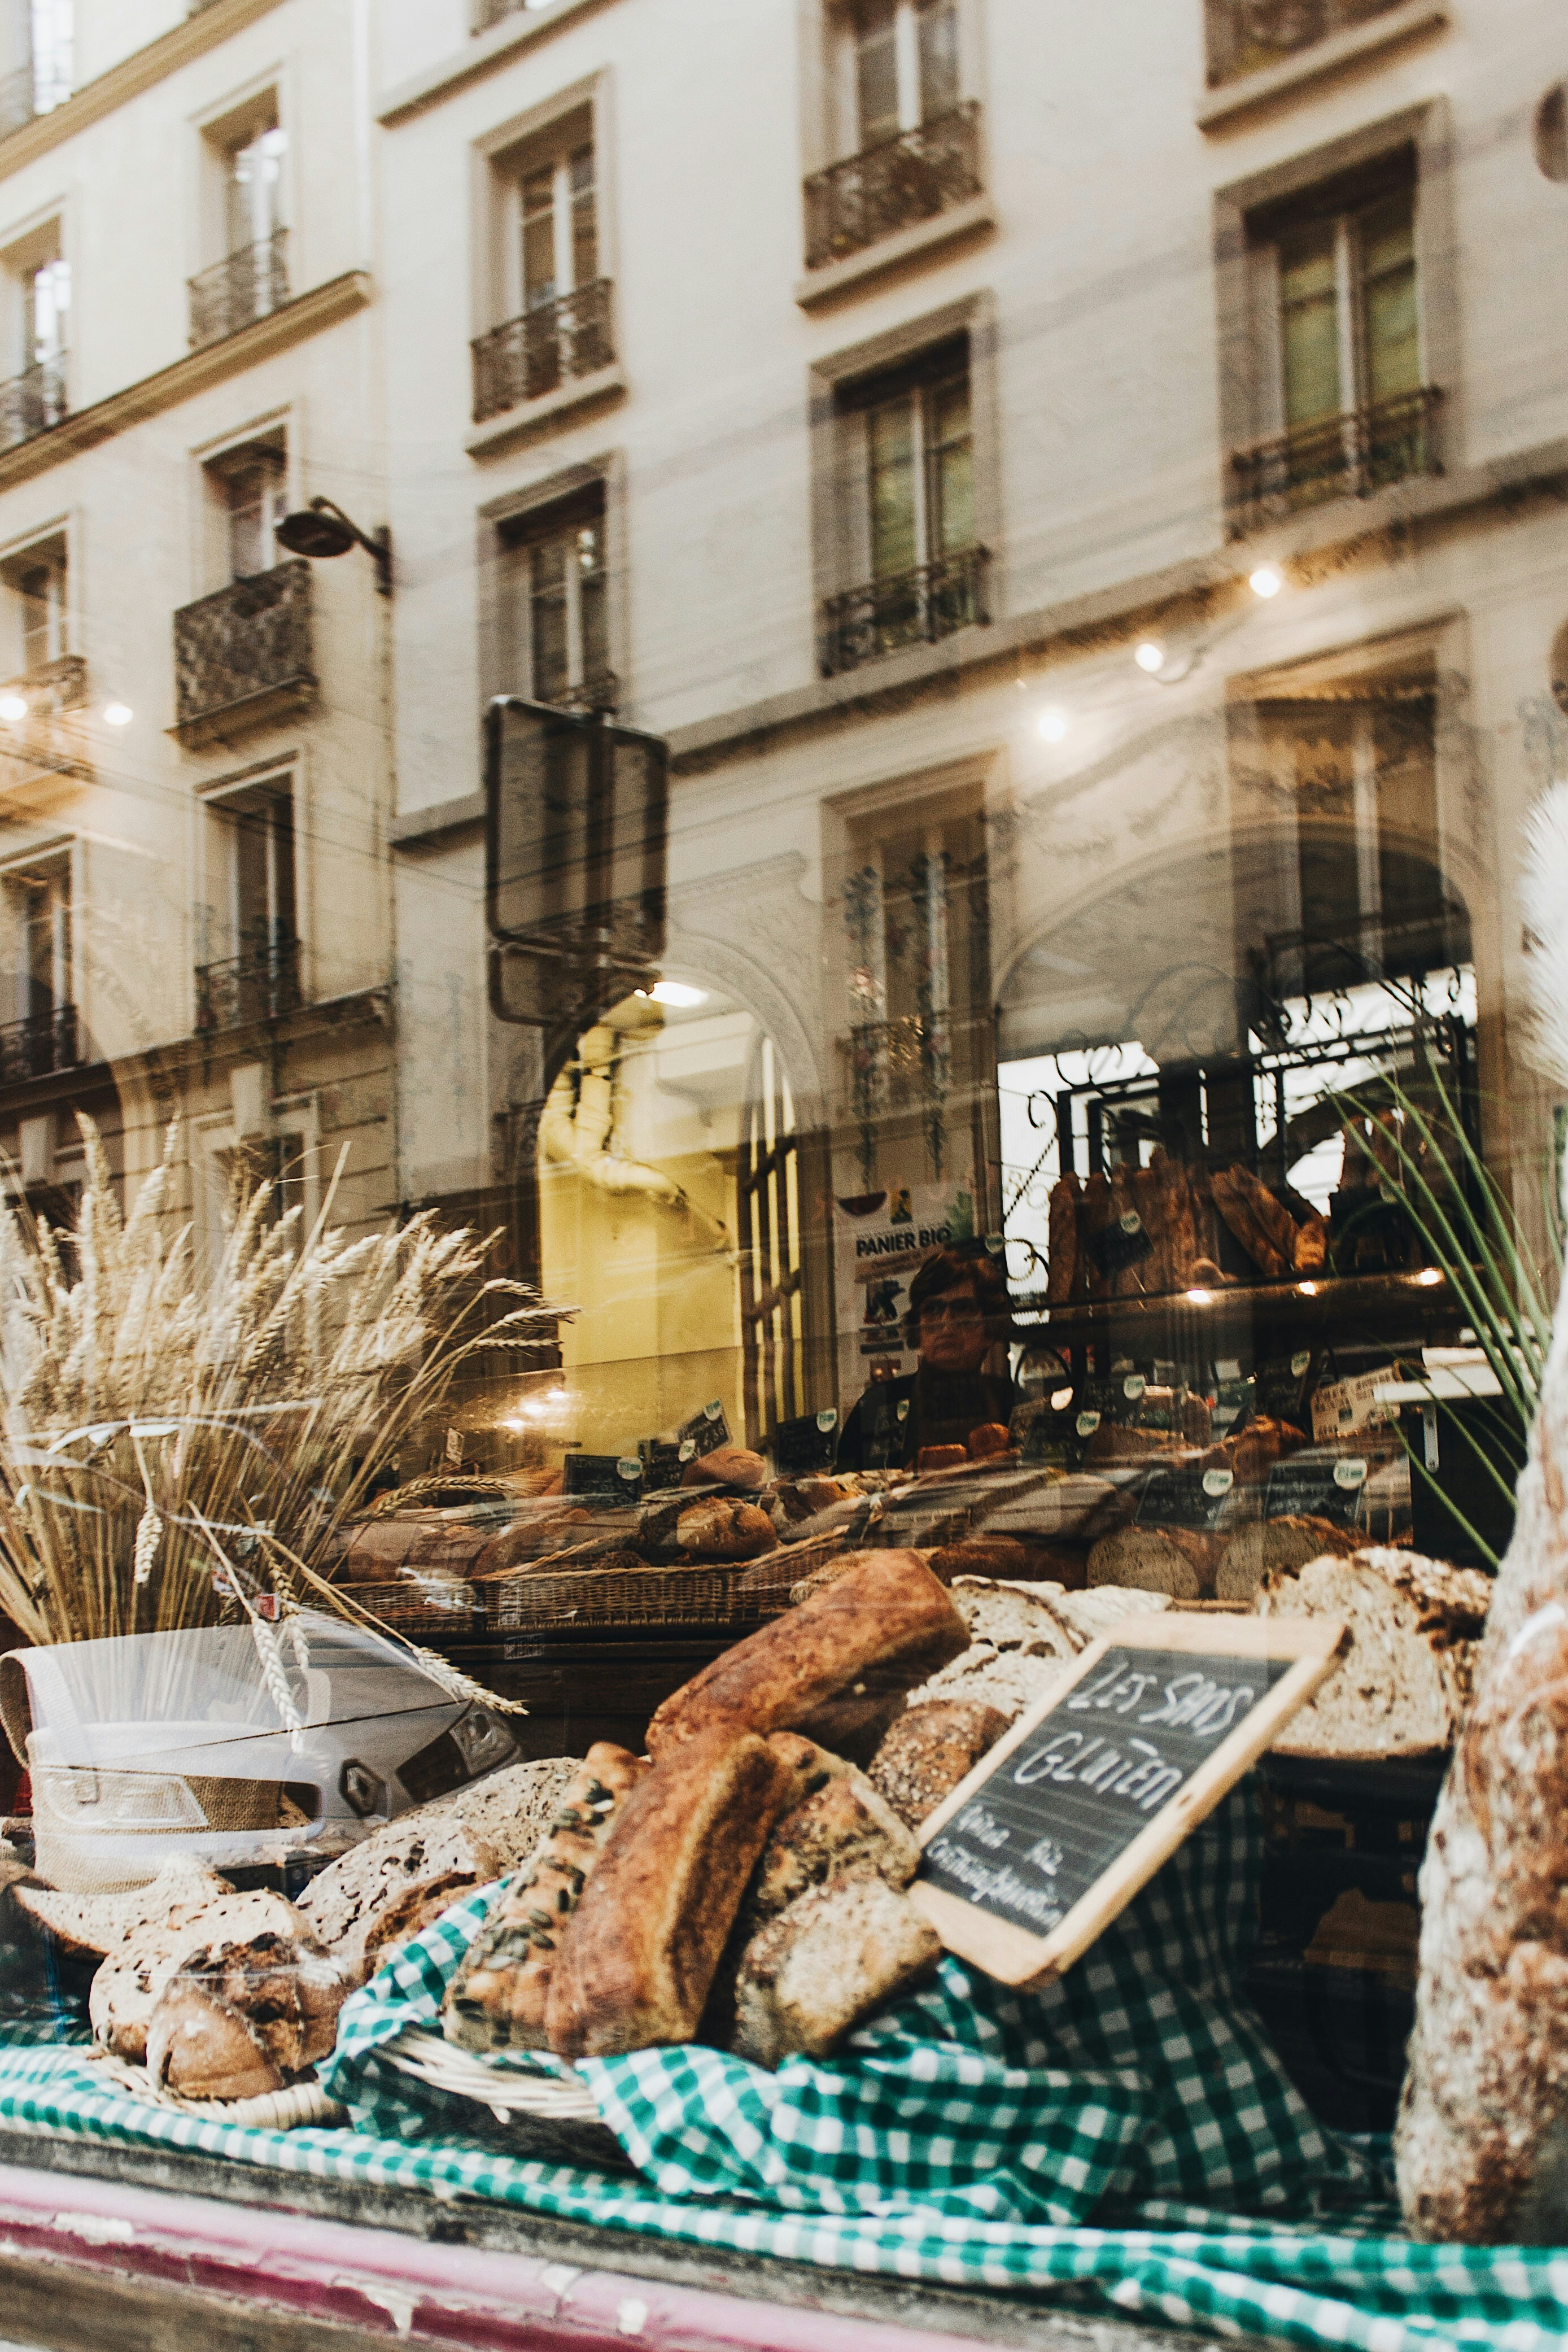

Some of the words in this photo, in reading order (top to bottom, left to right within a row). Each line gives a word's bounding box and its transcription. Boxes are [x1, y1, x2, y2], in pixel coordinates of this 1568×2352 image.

[856, 1232, 916, 1257] PANIER
[918, 1226, 952, 1247] BIO
[1068, 1661, 1158, 1713] LES
[1139, 1672, 1255, 1736] SANS
